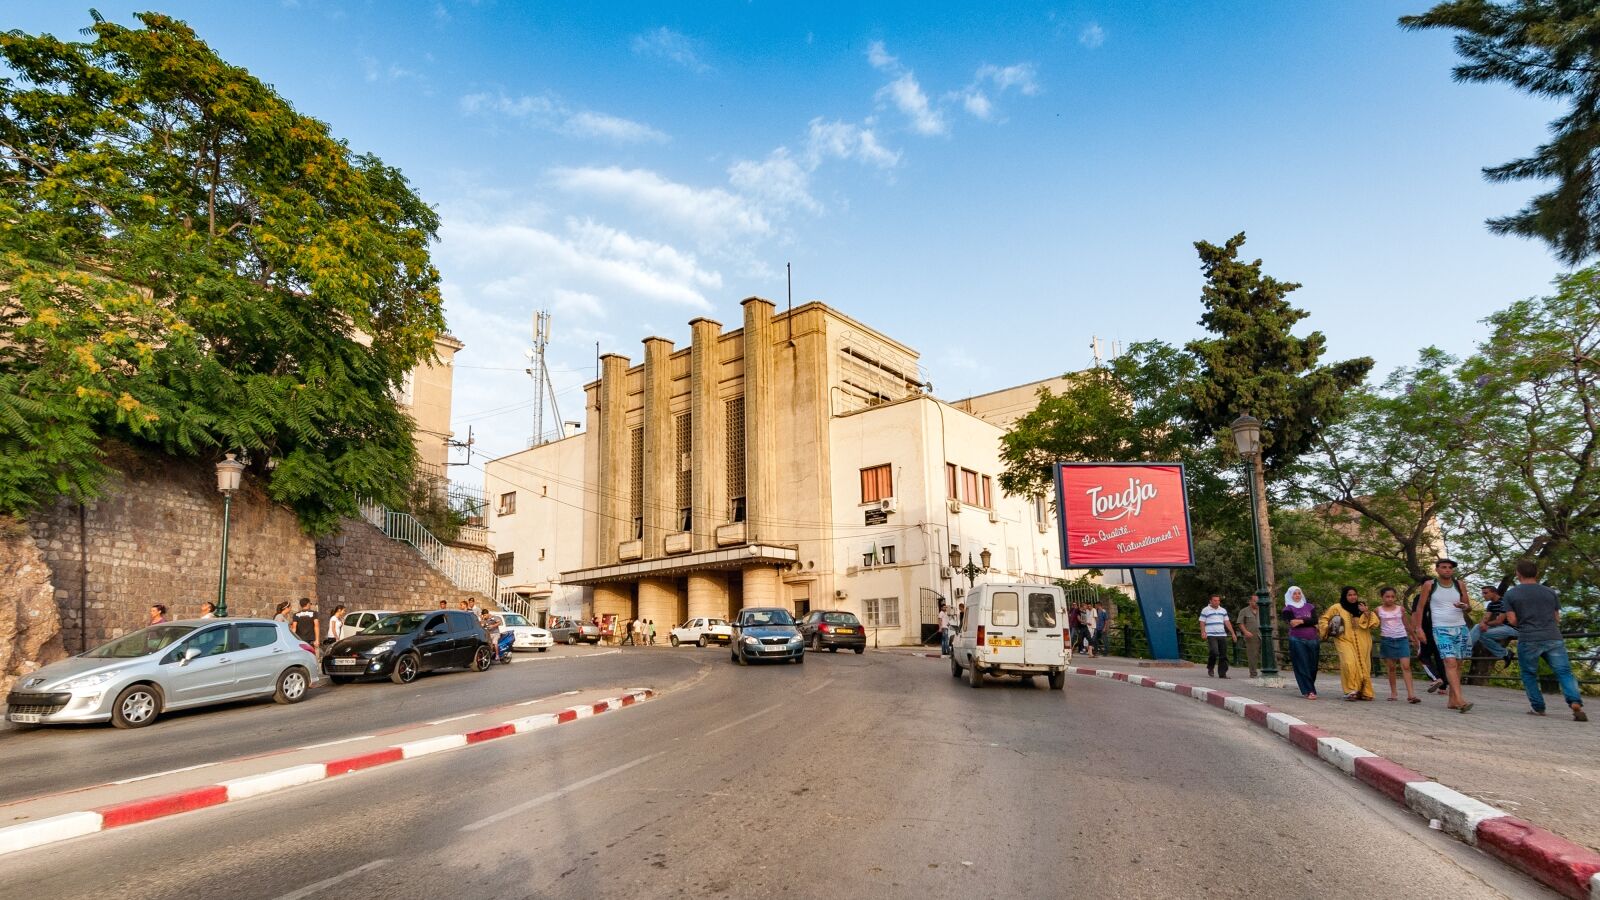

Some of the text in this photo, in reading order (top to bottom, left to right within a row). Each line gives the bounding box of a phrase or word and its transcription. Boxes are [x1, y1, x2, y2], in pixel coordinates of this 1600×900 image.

[1086, 478, 1157, 516] Toudja
[1082, 535, 1097, 547] La
[1117, 531, 1173, 554] Naturellement
